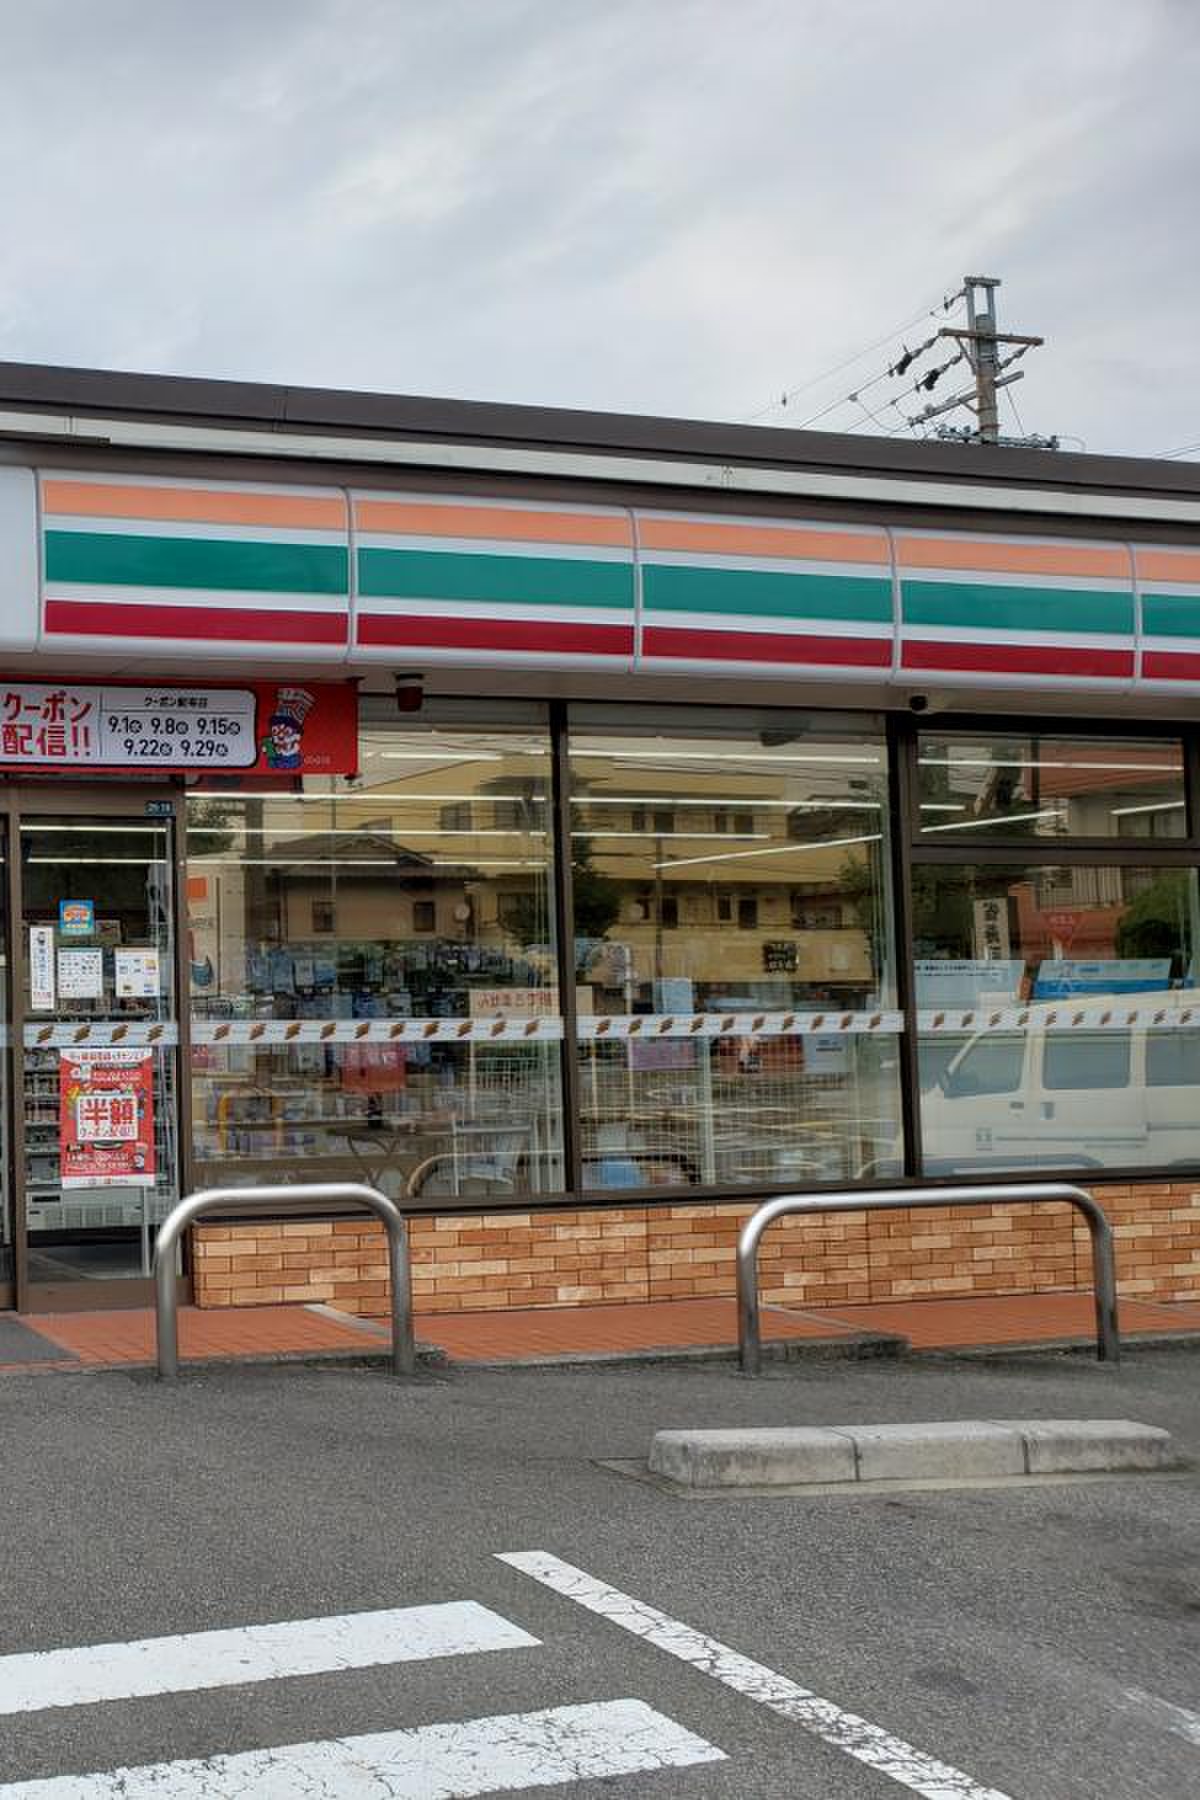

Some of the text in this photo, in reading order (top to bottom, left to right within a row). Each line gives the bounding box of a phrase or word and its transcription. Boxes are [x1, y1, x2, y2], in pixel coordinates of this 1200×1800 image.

[3, 689, 93, 723] クーポン
[1, 723, 92, 757] 配信!!
